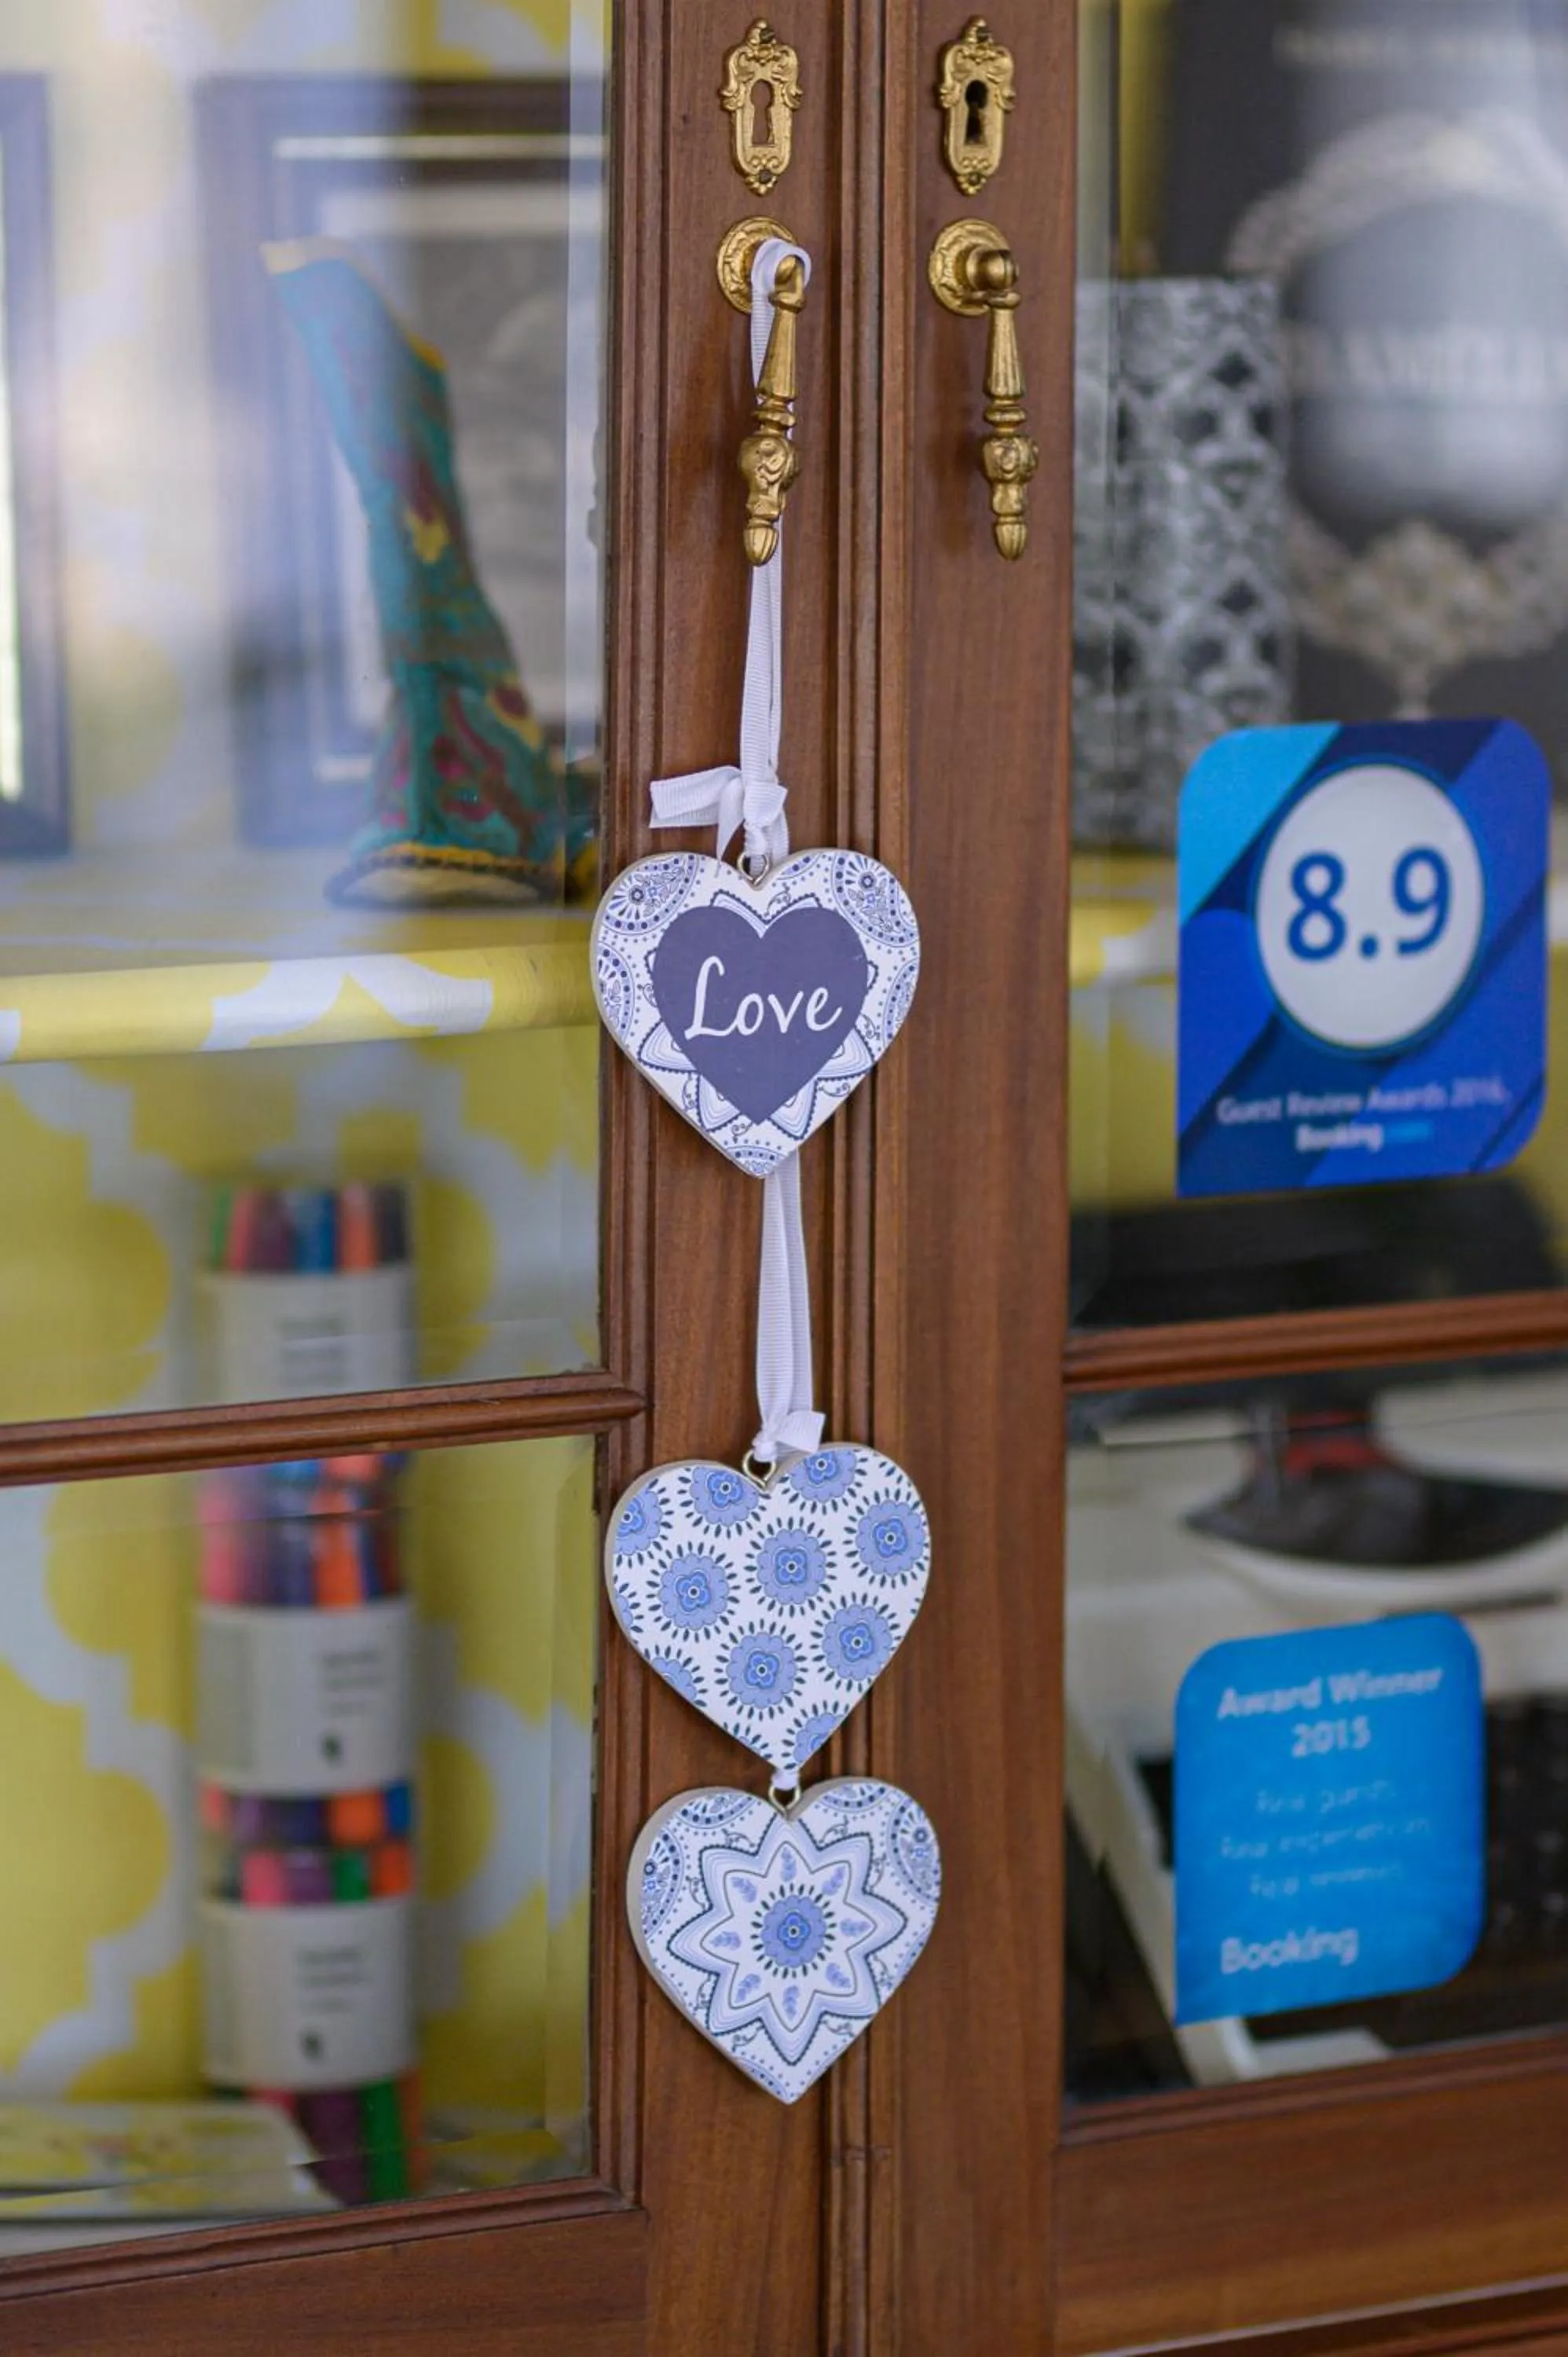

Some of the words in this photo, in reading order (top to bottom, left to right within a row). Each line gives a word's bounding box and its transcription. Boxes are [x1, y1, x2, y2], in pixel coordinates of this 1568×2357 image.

[1287, 845, 1452, 962] 8.9
[684, 955, 843, 1041] Love
[1218, 1677, 1323, 1720] Award
[1328, 1668, 1443, 1705] Winner
[1292, 1715, 1371, 1758] 2015
[1221, 1926, 1359, 1975] Booking
